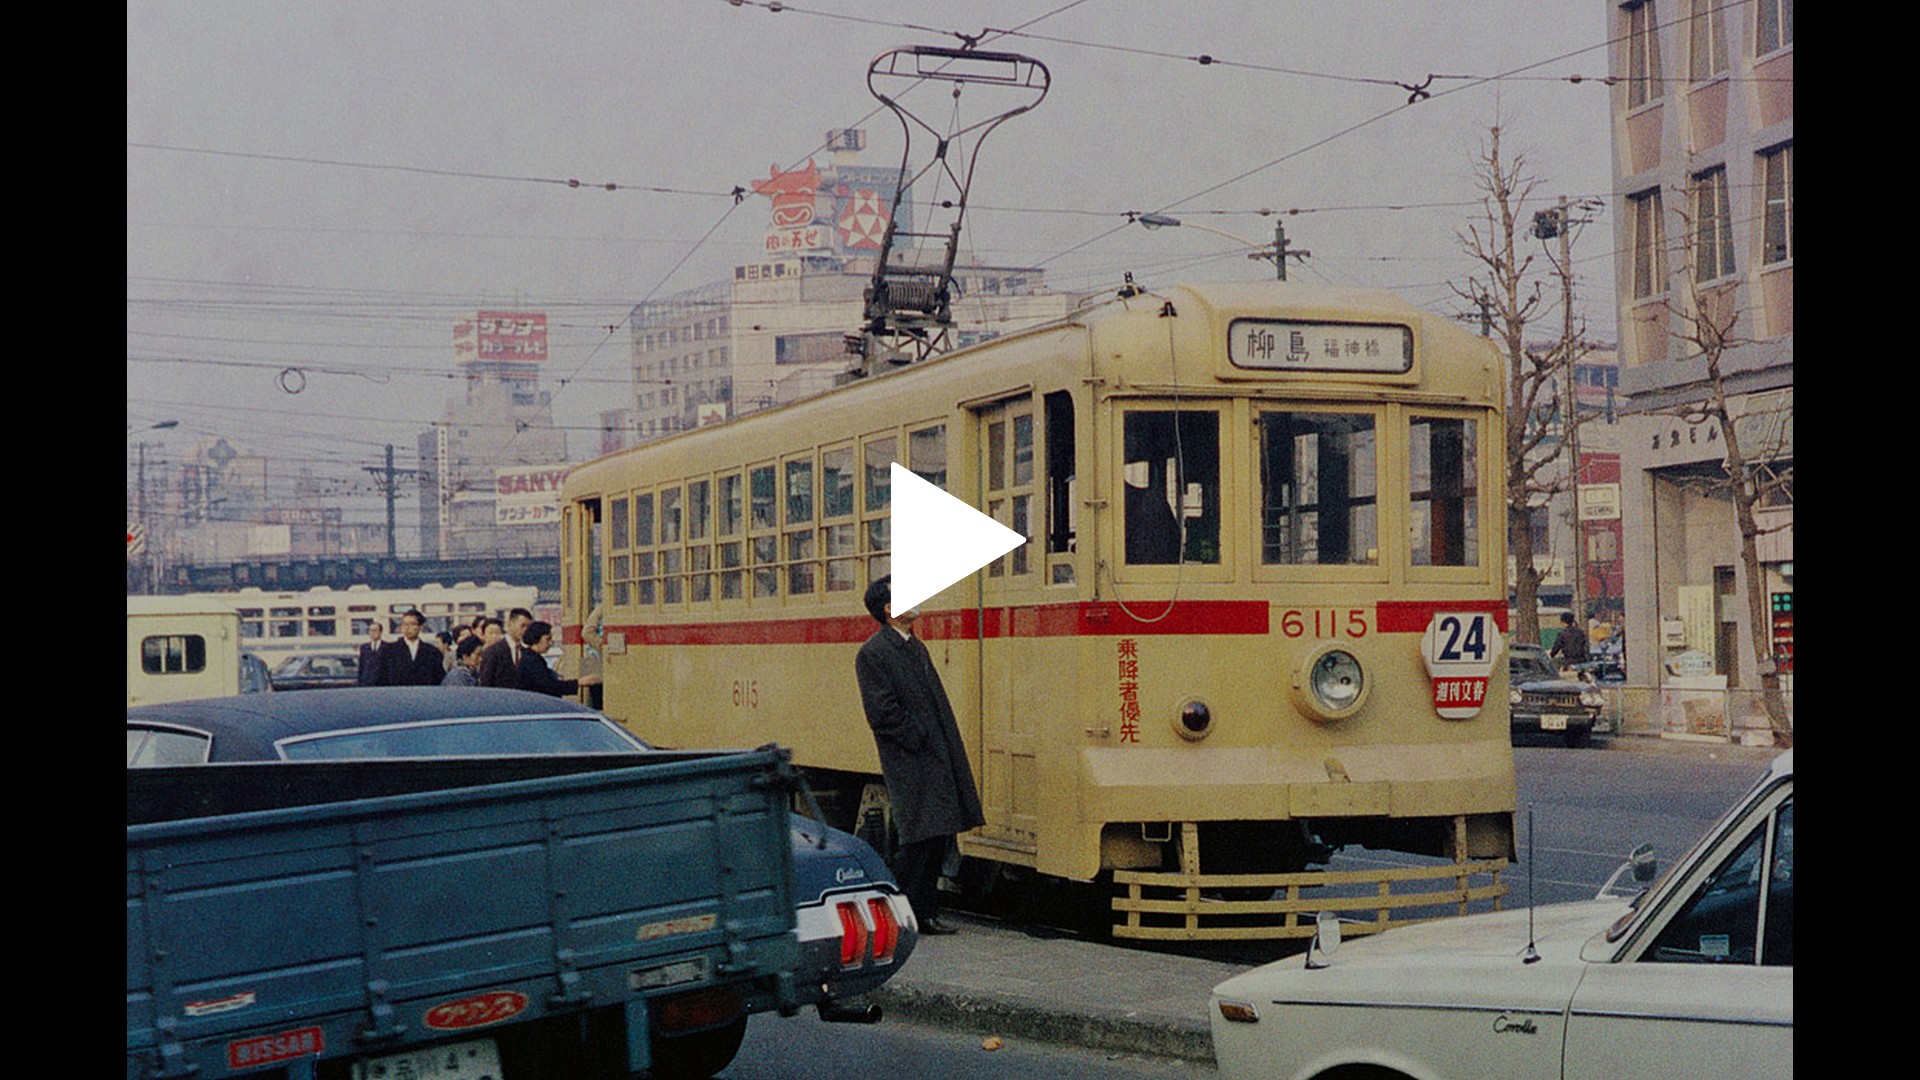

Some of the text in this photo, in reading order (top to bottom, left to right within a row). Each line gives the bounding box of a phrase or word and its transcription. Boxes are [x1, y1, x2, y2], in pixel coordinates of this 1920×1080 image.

[766, 228, 818, 250] 肉の万世
[479, 318, 545, 336] サンヨー
[481, 338, 545, 354] カラーテレビ
[1246, 328, 1380, 363] 柳島 福神橋
[1281, 609, 1368, 639] 6115
[1438, 616, 1486, 660] 24
[732, 680, 759, 709] 6115
[1116, 638, 1141, 743] 乗降者優先
[1436, 680, 1485, 702] 週刊文春
[1493, 1015, 1538, 1034] Corolla
[236, 1031, 315, 1064] NISSAN
